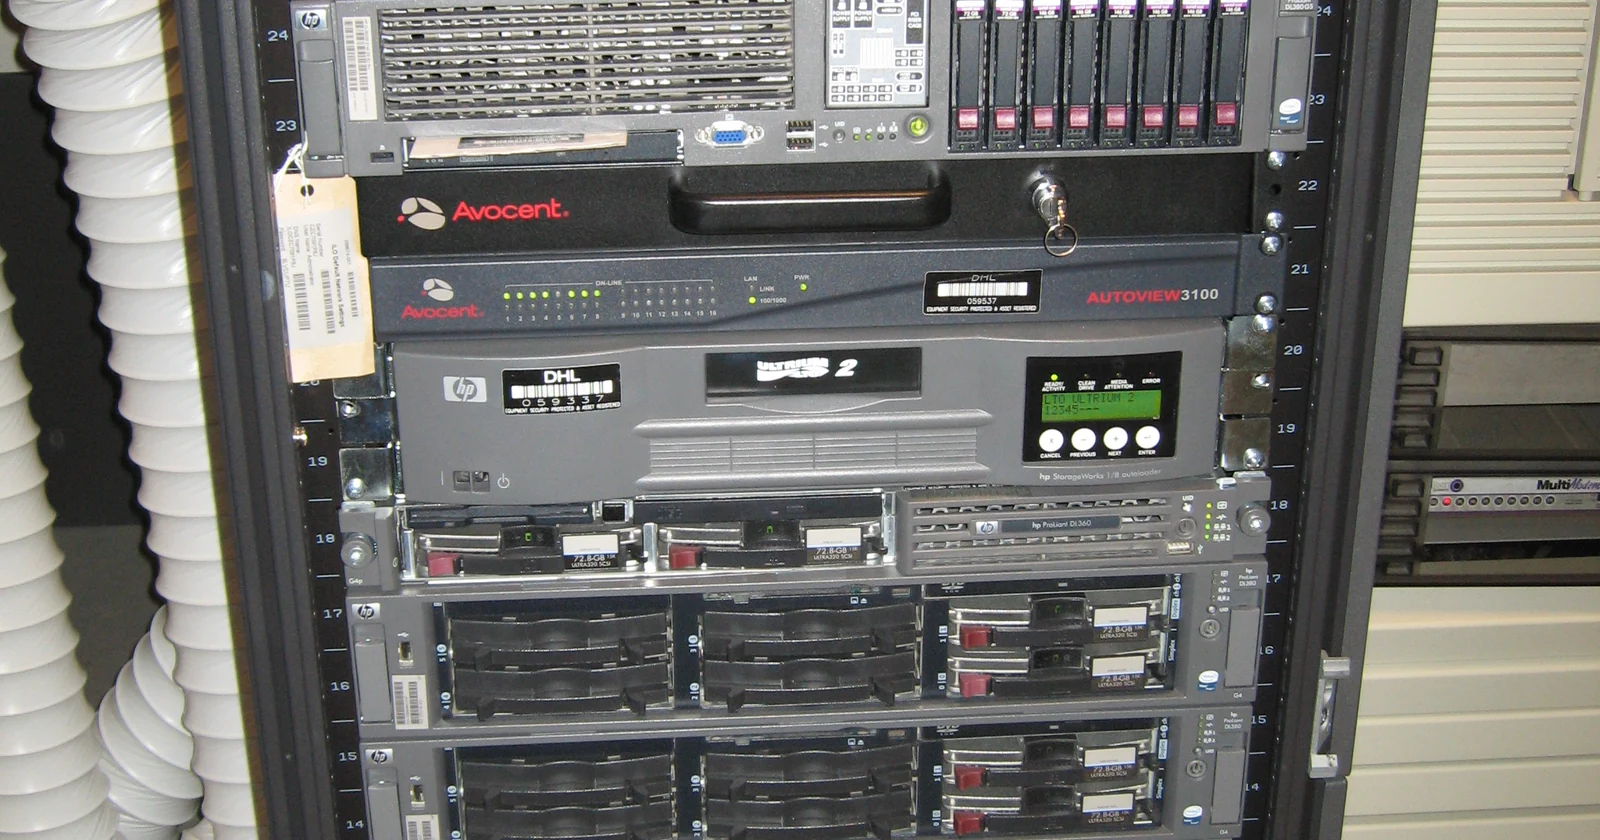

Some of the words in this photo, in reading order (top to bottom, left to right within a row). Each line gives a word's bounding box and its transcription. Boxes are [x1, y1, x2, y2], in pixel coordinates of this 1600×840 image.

[268, 31, 288, 42] 24
[275, 121, 297, 131] 23
[1298, 180, 1317, 190] 22
[452, 198, 562, 222] Avocent
[1291, 264, 1309, 275] 21
[401, 303, 478, 320] Avocent
[1284, 345, 1302, 356] 20
[757, 357, 828, 370] ULTRIUM
[834, 359, 858, 377] 2
[544, 370, 581, 383] DHL
[1044, 394, 1066, 404] LTO
[1073, 393, 1121, 404] ULTRIUM
[1128, 393, 1135, 402] 2
[1278, 424, 1296, 434] 19
[308, 457, 327, 466] 19
[1053, 471, 1104, 481] StorageWorks
[1122, 468, 1161, 477] autoloader
[1271, 500, 1288, 510] 18
[1032, 522, 1041, 530] hp
[316, 534, 335, 543] 18
[324, 609, 342, 619] 17
[331, 682, 350, 691] 16
[1252, 715, 1266, 724] 15
[339, 752, 357, 761] 15
[1246, 783, 1259, 791] 14
[346, 820, 364, 829] 14
